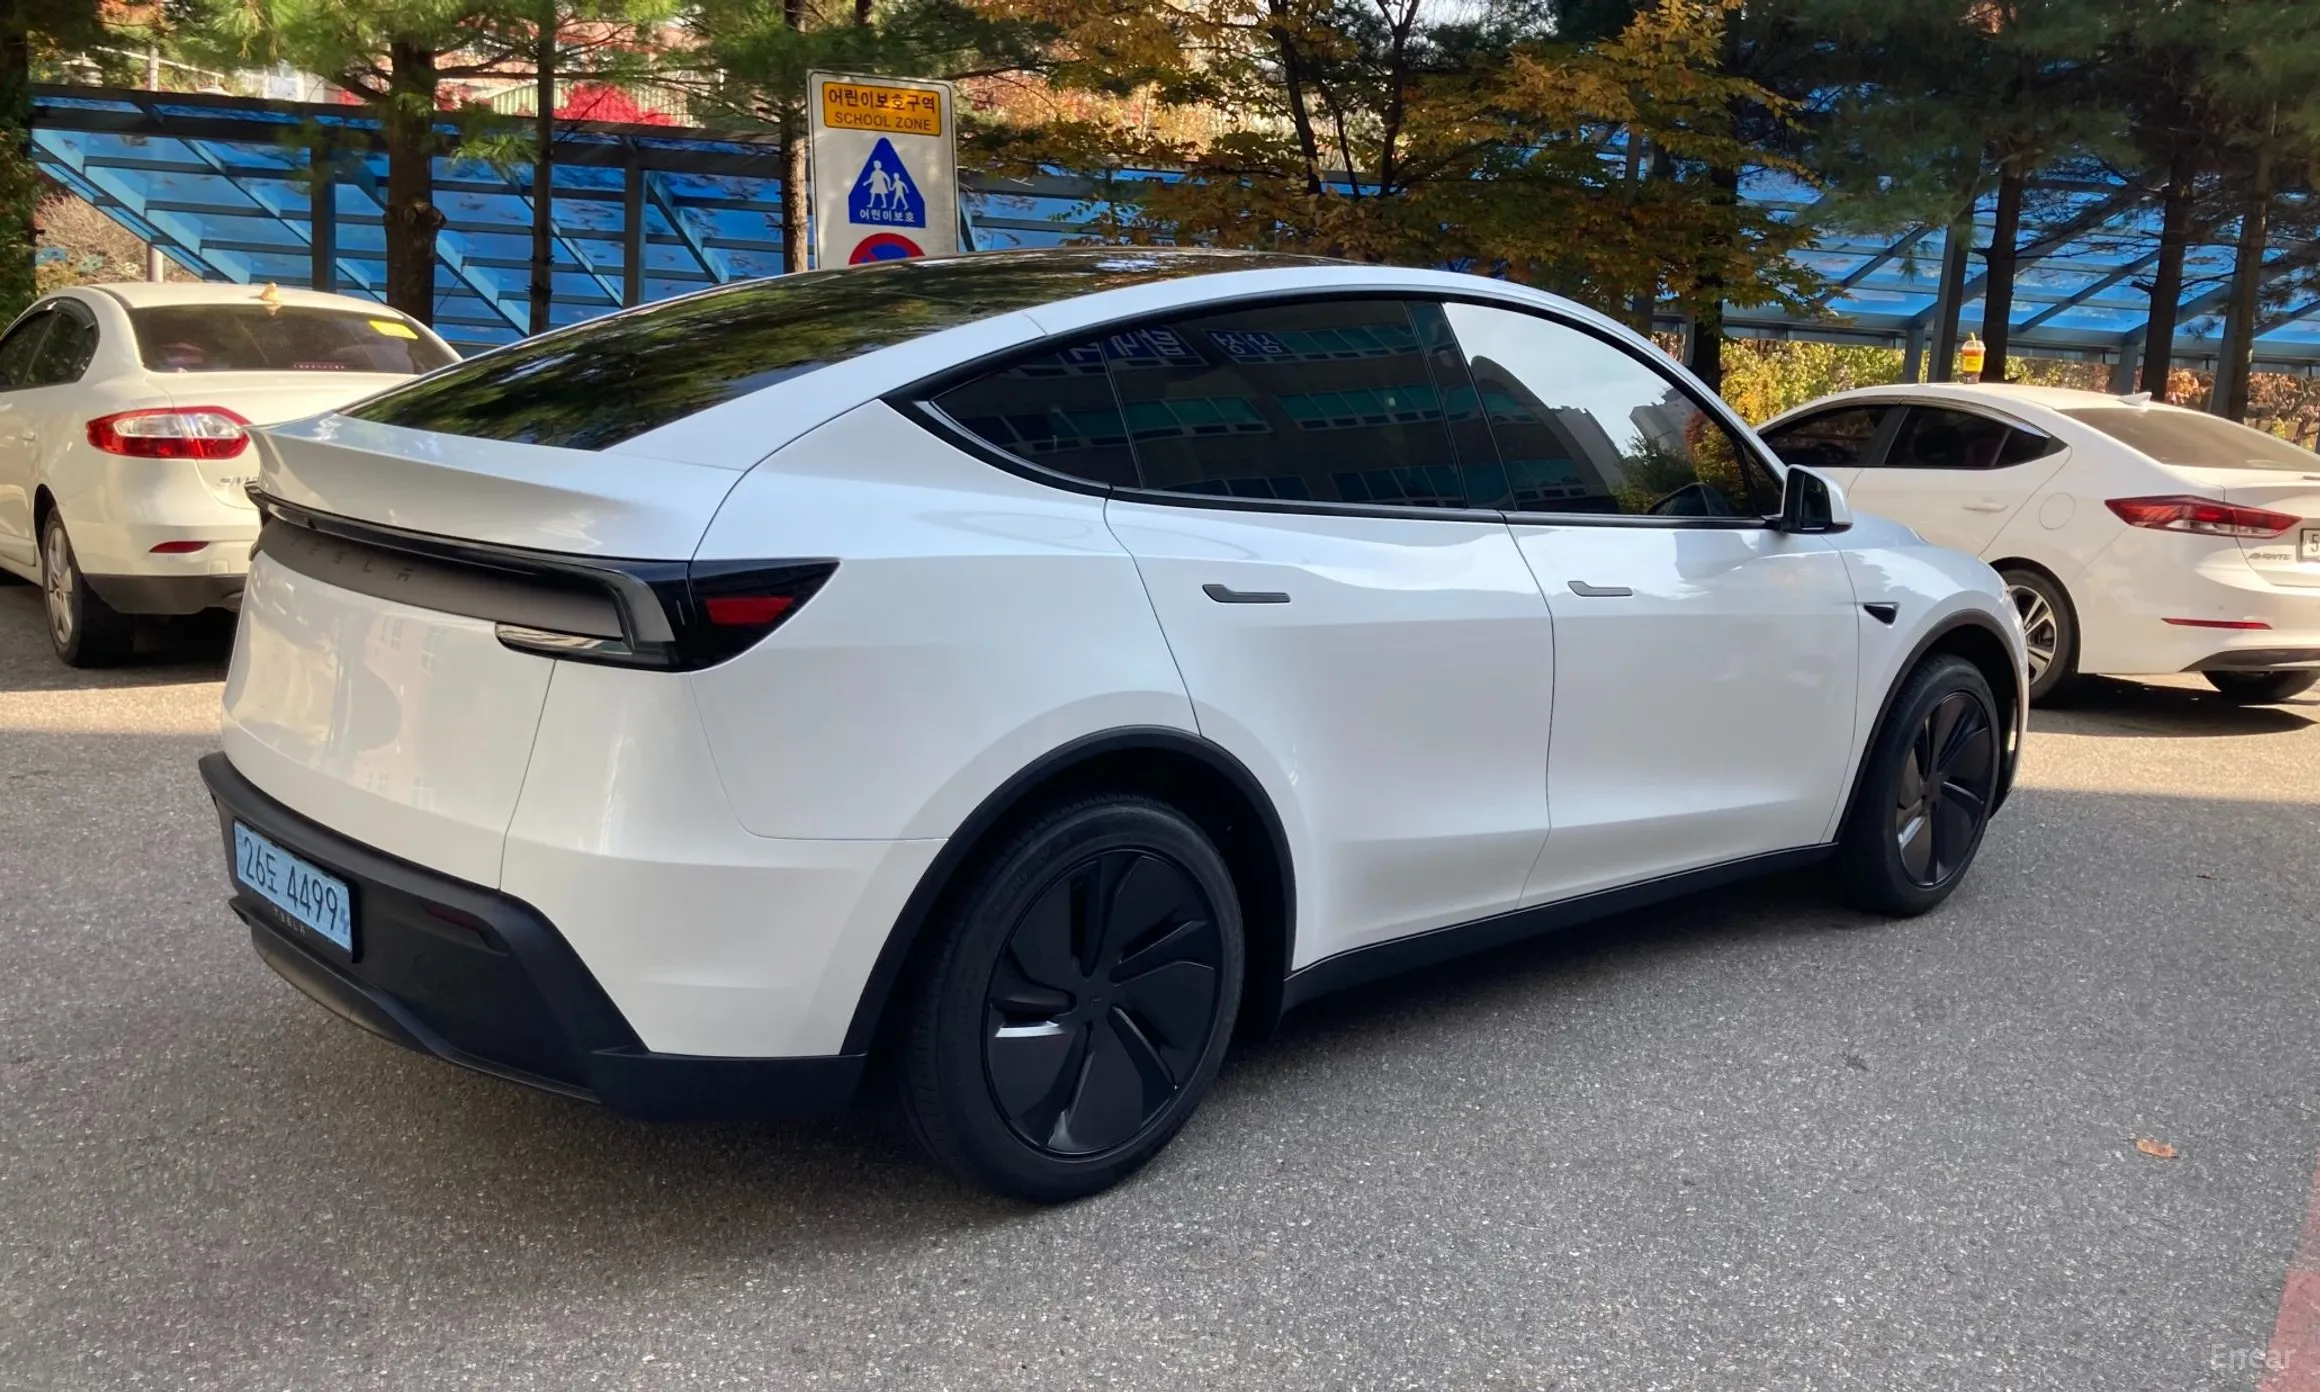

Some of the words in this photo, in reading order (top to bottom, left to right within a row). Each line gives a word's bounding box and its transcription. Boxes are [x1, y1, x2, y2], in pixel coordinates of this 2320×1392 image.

[828, 88, 936, 113] 어린이보호구역
[834, 111, 891, 128] SCHOOL
[895, 116, 931, 131] ZONE
[859, 208, 916, 223] 어린이보호
[244, 836, 279, 894] 26도
[286, 865, 338, 931] 4499
